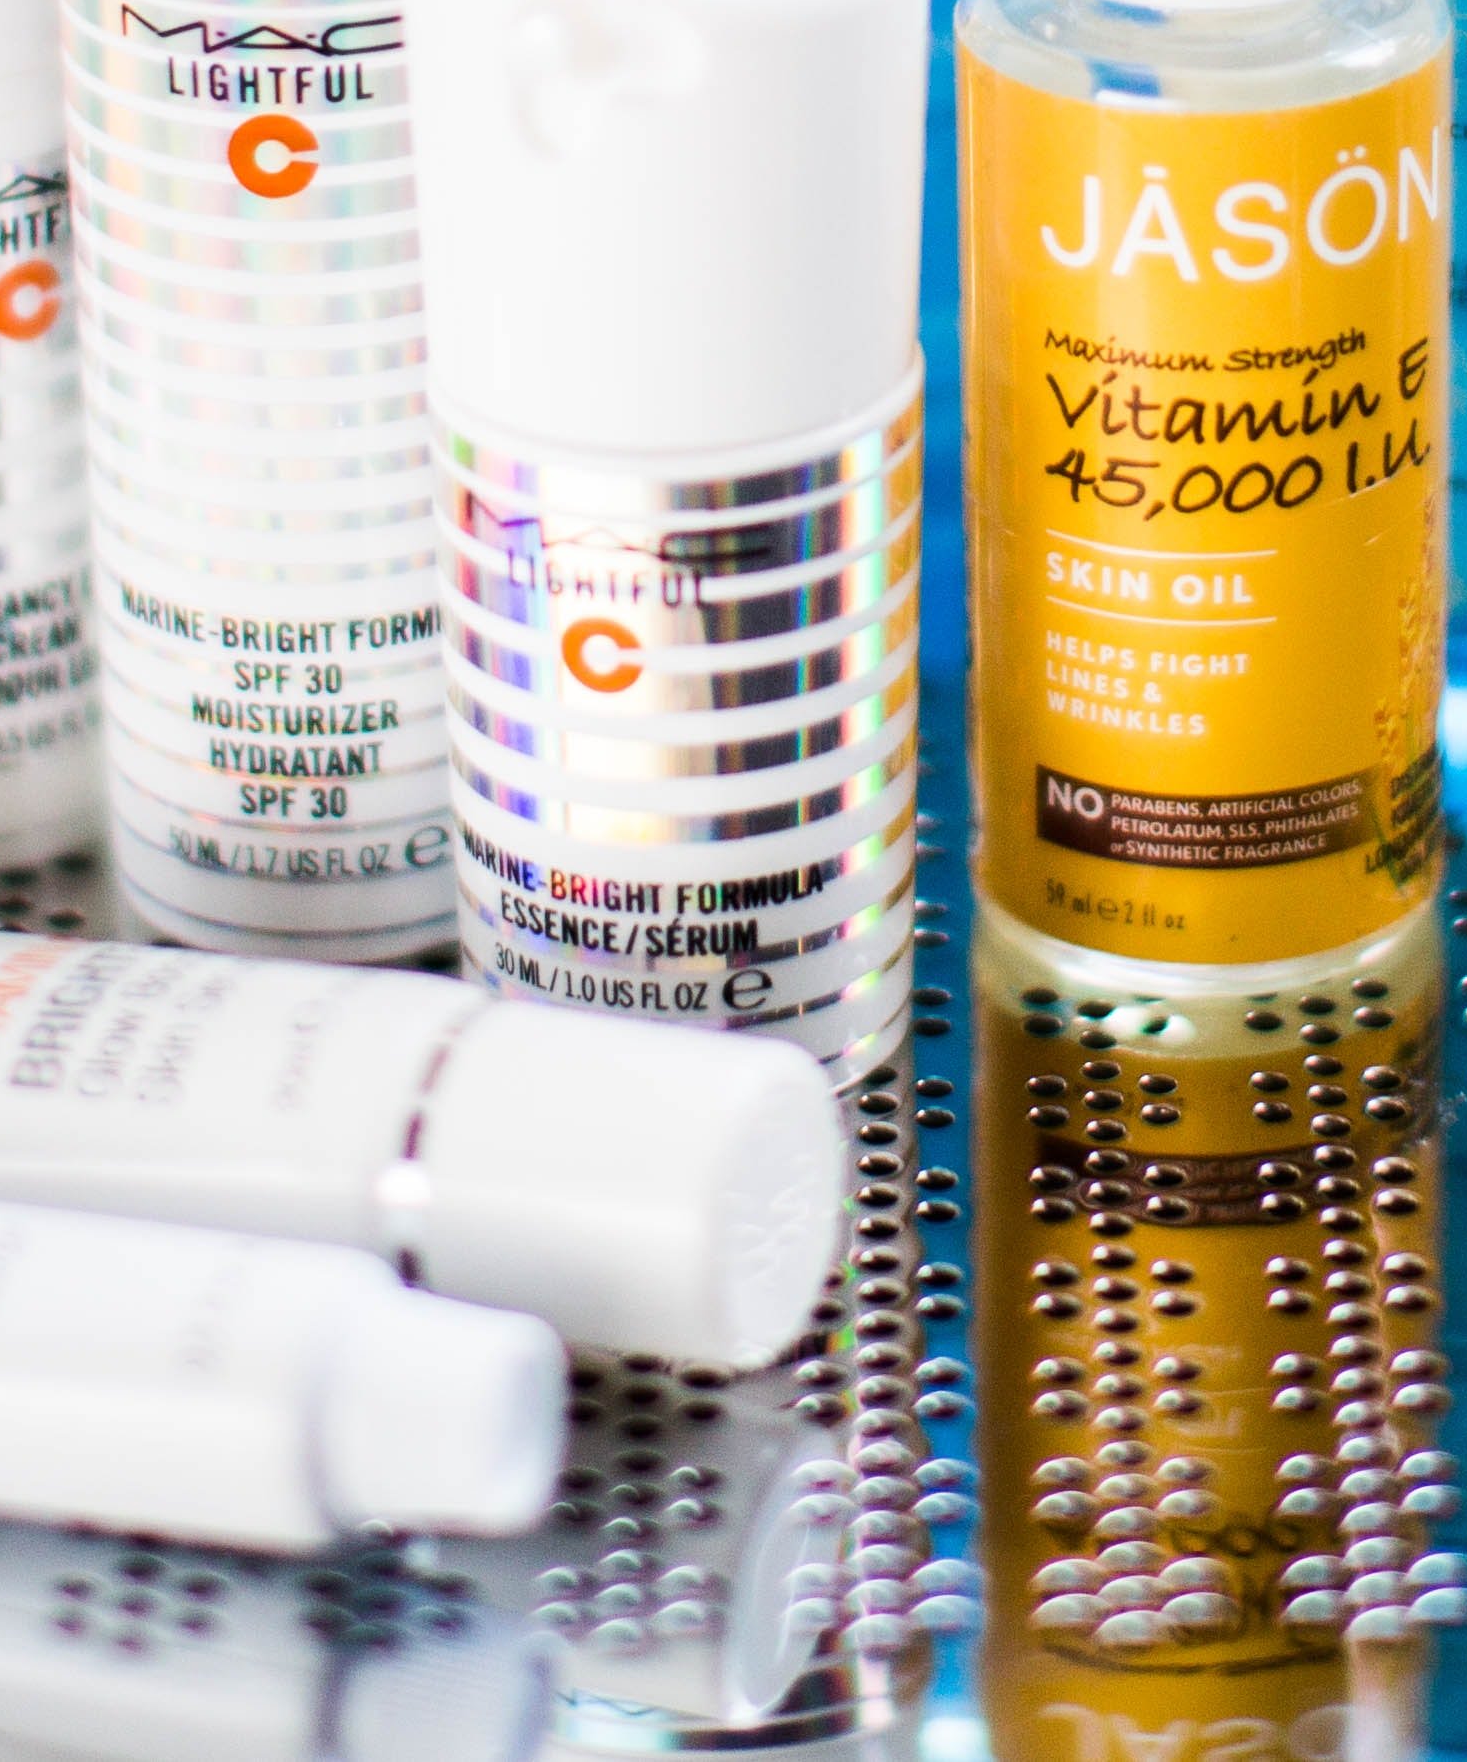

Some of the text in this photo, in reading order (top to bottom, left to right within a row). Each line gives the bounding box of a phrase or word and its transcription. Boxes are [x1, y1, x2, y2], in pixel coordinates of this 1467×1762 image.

[167, 57, 376, 104] LIGHTFUL
[228, 113, 319, 199] C
[1043, 328, 1367, 373] Maximum Strength
[1045, 369, 1381, 446] Vitamin
[1399, 336, 1429, 401] E
[1045, 449, 1324, 522] 45,000
[507, 547, 707, 610] LIGHTFUL
[1046, 553, 1255, 605] SKIN OIL
[121, 582, 336, 655] MARINE-BRIGHT
[561, 617, 644, 693] C
[1046, 628, 1251, 676] HELPS FIGHT
[234, 660, 343, 696] SPF 30
[1046, 659, 1166, 704] LINES &
[191, 693, 400, 737] MOISTURIZER
[1046, 690, 1208, 737] WRINKLES
[210, 737, 384, 778] HYDRATANT
[240, 783, 349, 819] SPF 30
[1046, 776, 1105, 821] NO
[1110, 793, 1203, 819] PARABENS,
[1207, 795, 1295, 818] ARTIFICIAL
[1110, 815, 1226, 840] PETROLATUM,
[1110, 831, 1328, 862] or SYNTHETIC FRAGRANCE
[287, 847, 320, 879] US
[359, 842, 391, 876] OZ
[464, 824, 825, 916] MARINE-BRIGHT FORMULA
[495, 941, 515, 974] 30
[518, 951, 545, 987] ML
[564, 970, 596, 1004] 1.0
[602, 976, 634, 1008] US
[641, 980, 669, 1011] FL
[674, 982, 709, 1012] OZ
